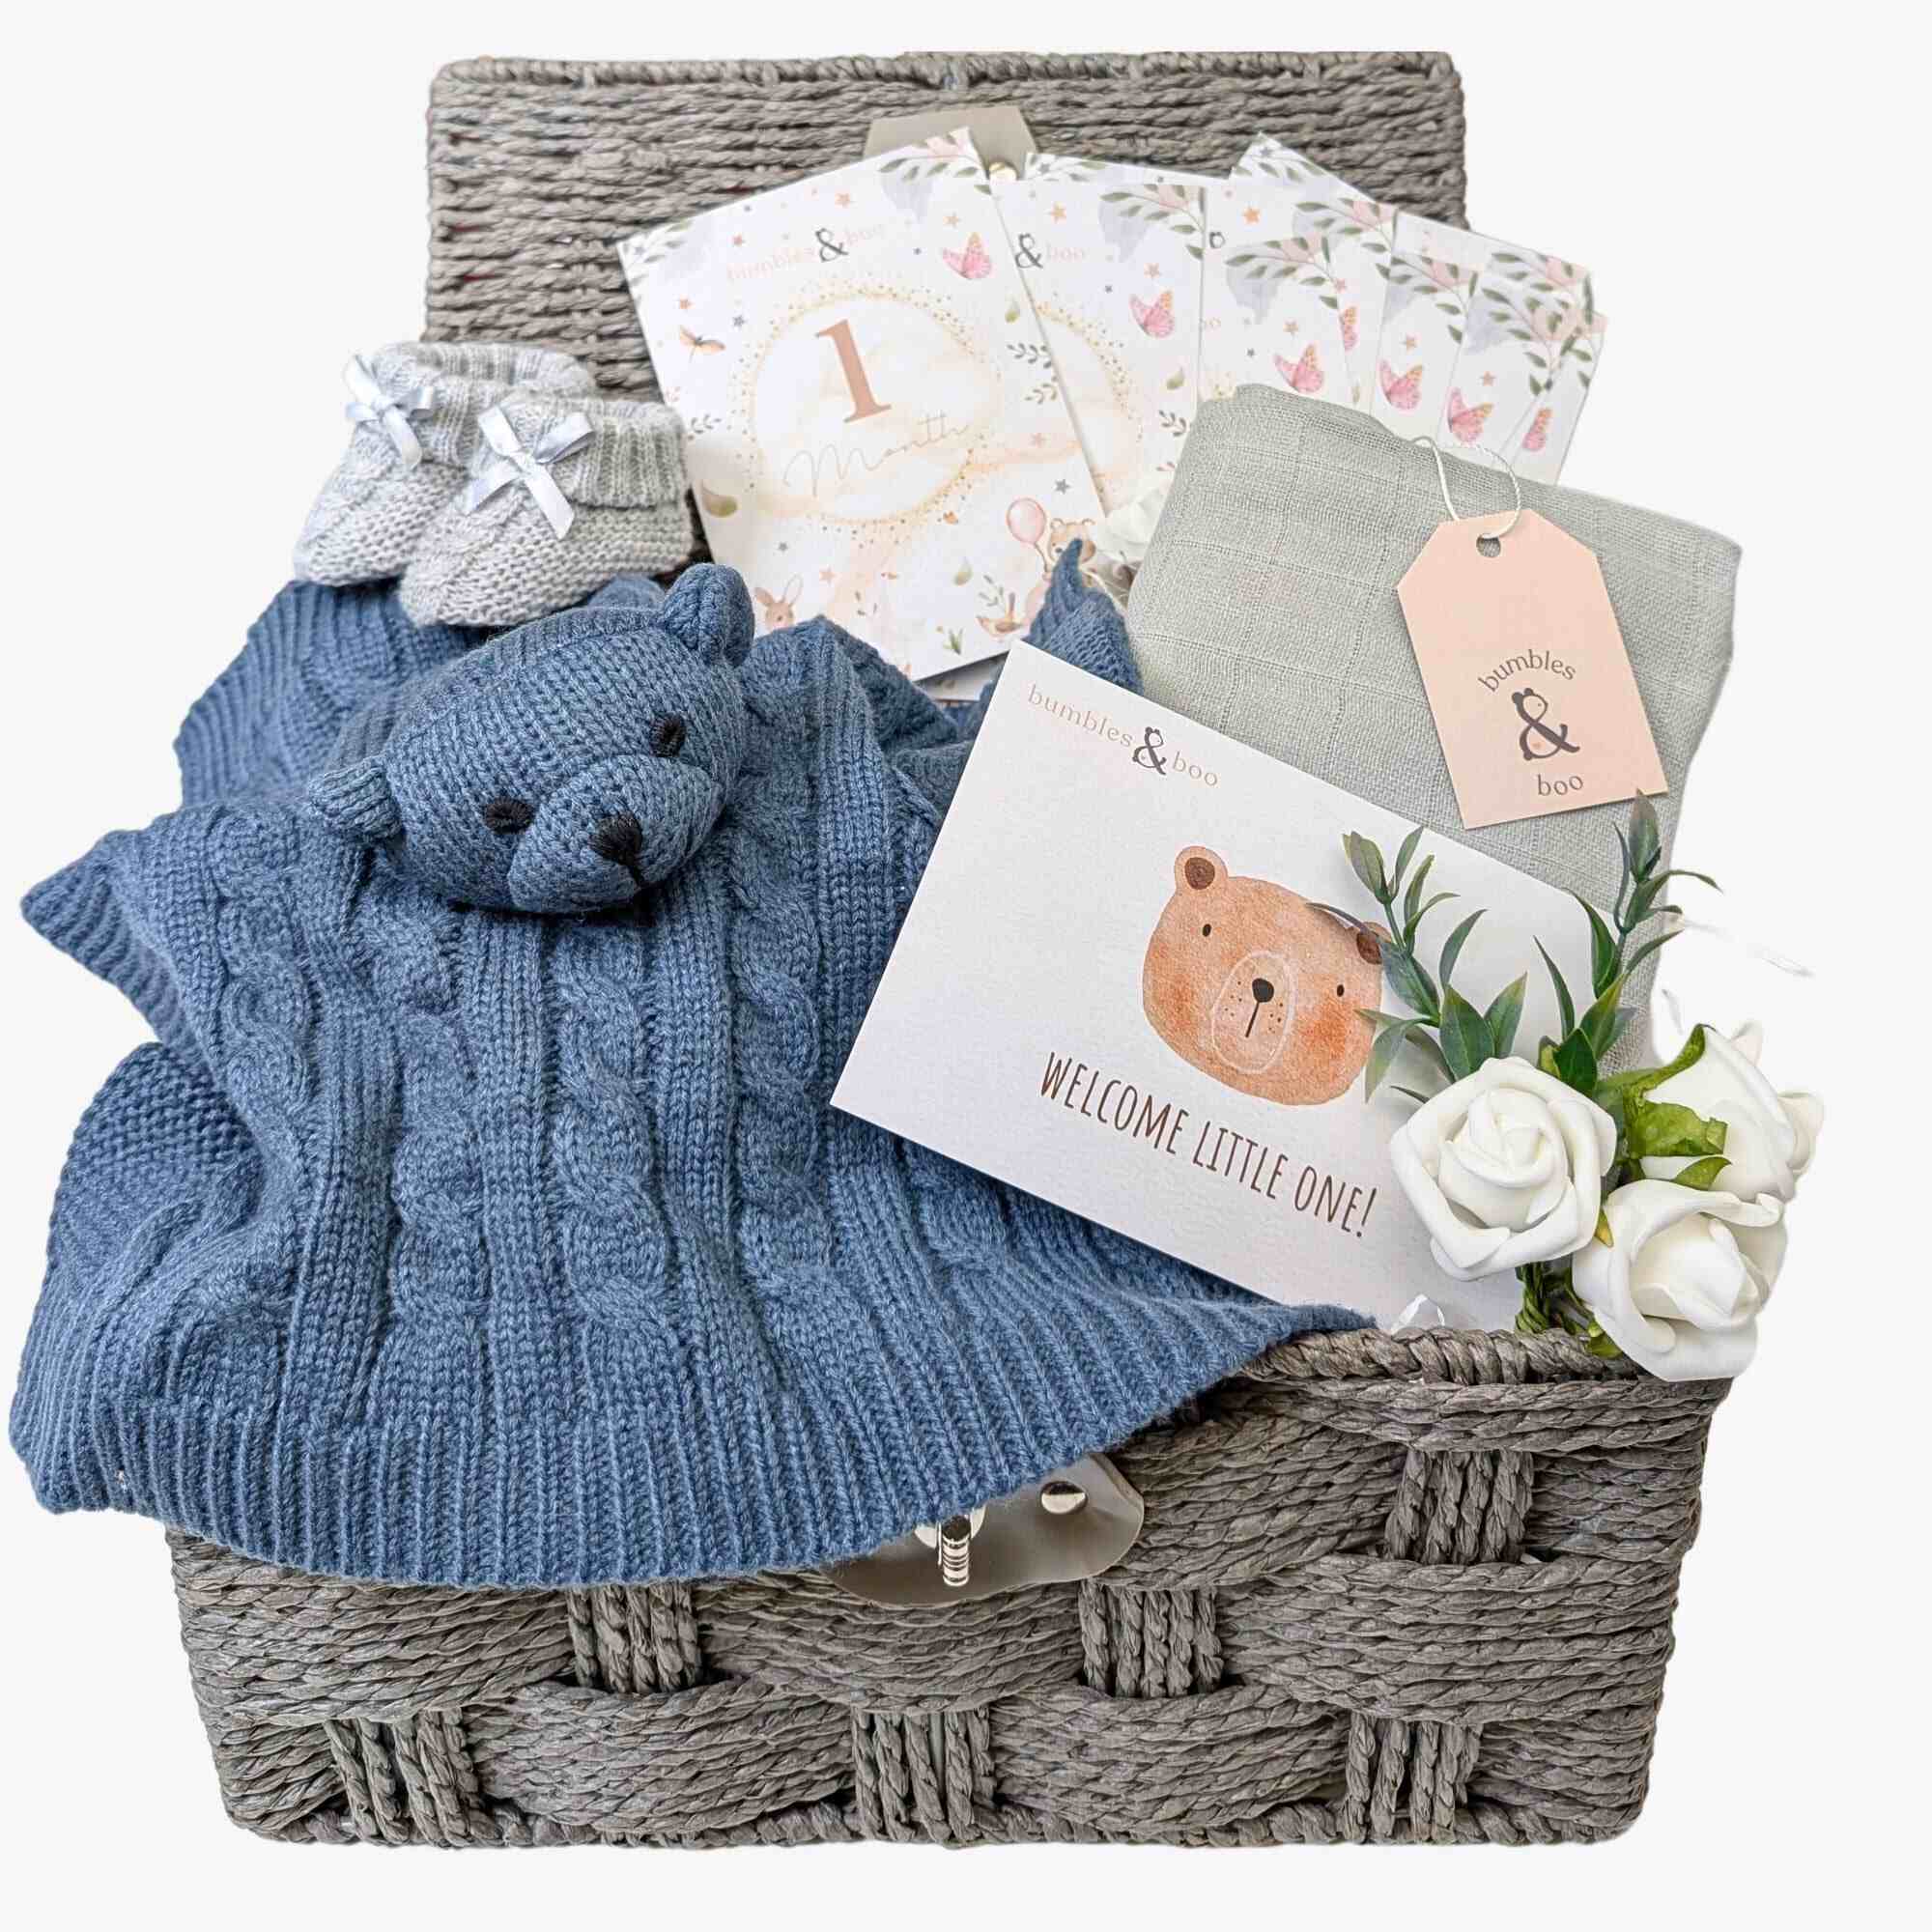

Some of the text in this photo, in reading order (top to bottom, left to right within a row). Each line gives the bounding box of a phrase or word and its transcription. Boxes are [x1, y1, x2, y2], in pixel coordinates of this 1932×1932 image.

[814, 317, 893, 423] 1
[782, 409, 971, 497] Month
[1478, 648, 1577, 693] bumbles
[1027, 682, 1133, 749] bumbles
[1172, 750, 1218, 787] boo
[1511, 687, 1581, 761] &
[1537, 773, 1584, 796] boo
[1038, 1051, 1377, 1237] WELCOME LITTLE ONE!
